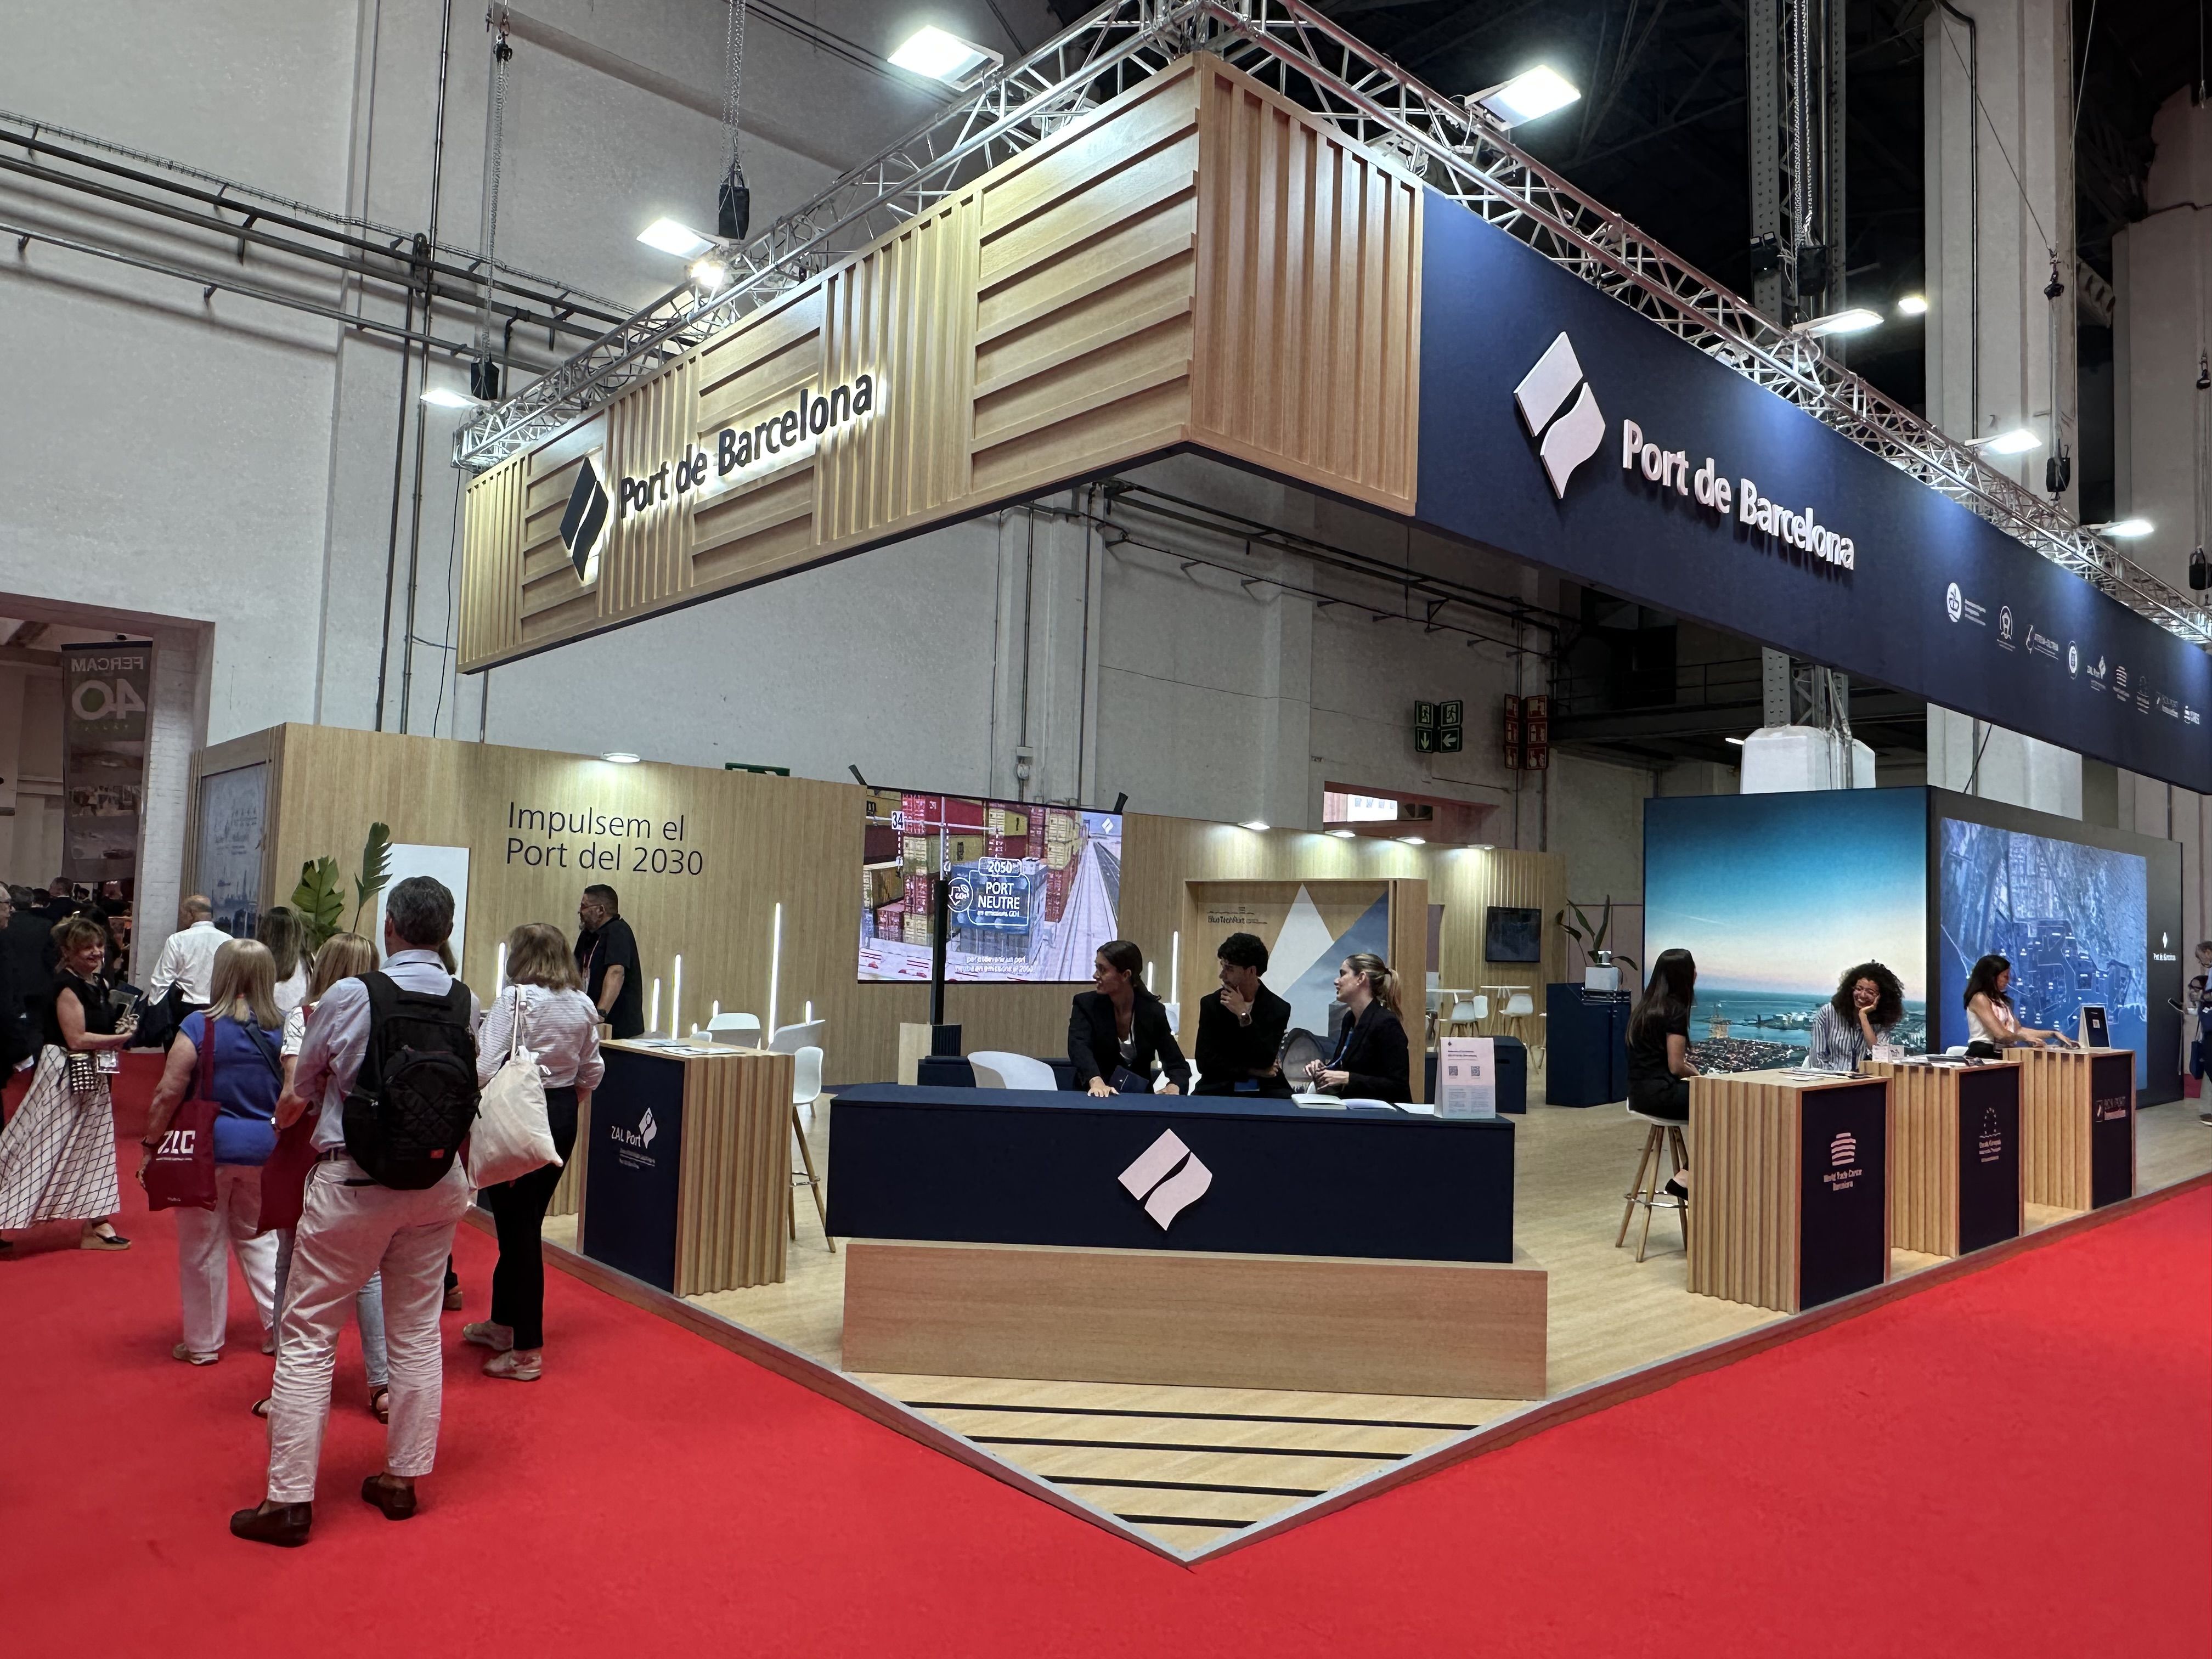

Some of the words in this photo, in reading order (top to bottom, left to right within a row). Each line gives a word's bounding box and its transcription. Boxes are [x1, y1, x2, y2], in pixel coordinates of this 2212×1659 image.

[621, 464, 669, 518] Port
[676, 445, 707, 494] de
[718, 374, 872, 476] Barcelona
[1623, 419, 1688, 496] Port
[1695, 458, 1731, 514] de
[1740, 478, 1854, 570] Barcelona
[509, 801, 651, 839] Impulsem
[663, 814, 684, 841] el
[892, 811, 904, 828] 34
[506, 837, 568, 867] Port
[579, 842, 620, 871] del
[633, 847, 703, 876] 2030
[988, 861, 1013, 873] 2050
[986, 881, 1014, 895] PORT
[978, 895, 1020, 910] NEUTRE
[611, 1125, 624, 1142] ZAL
[627, 1130, 641, 1147] Port
